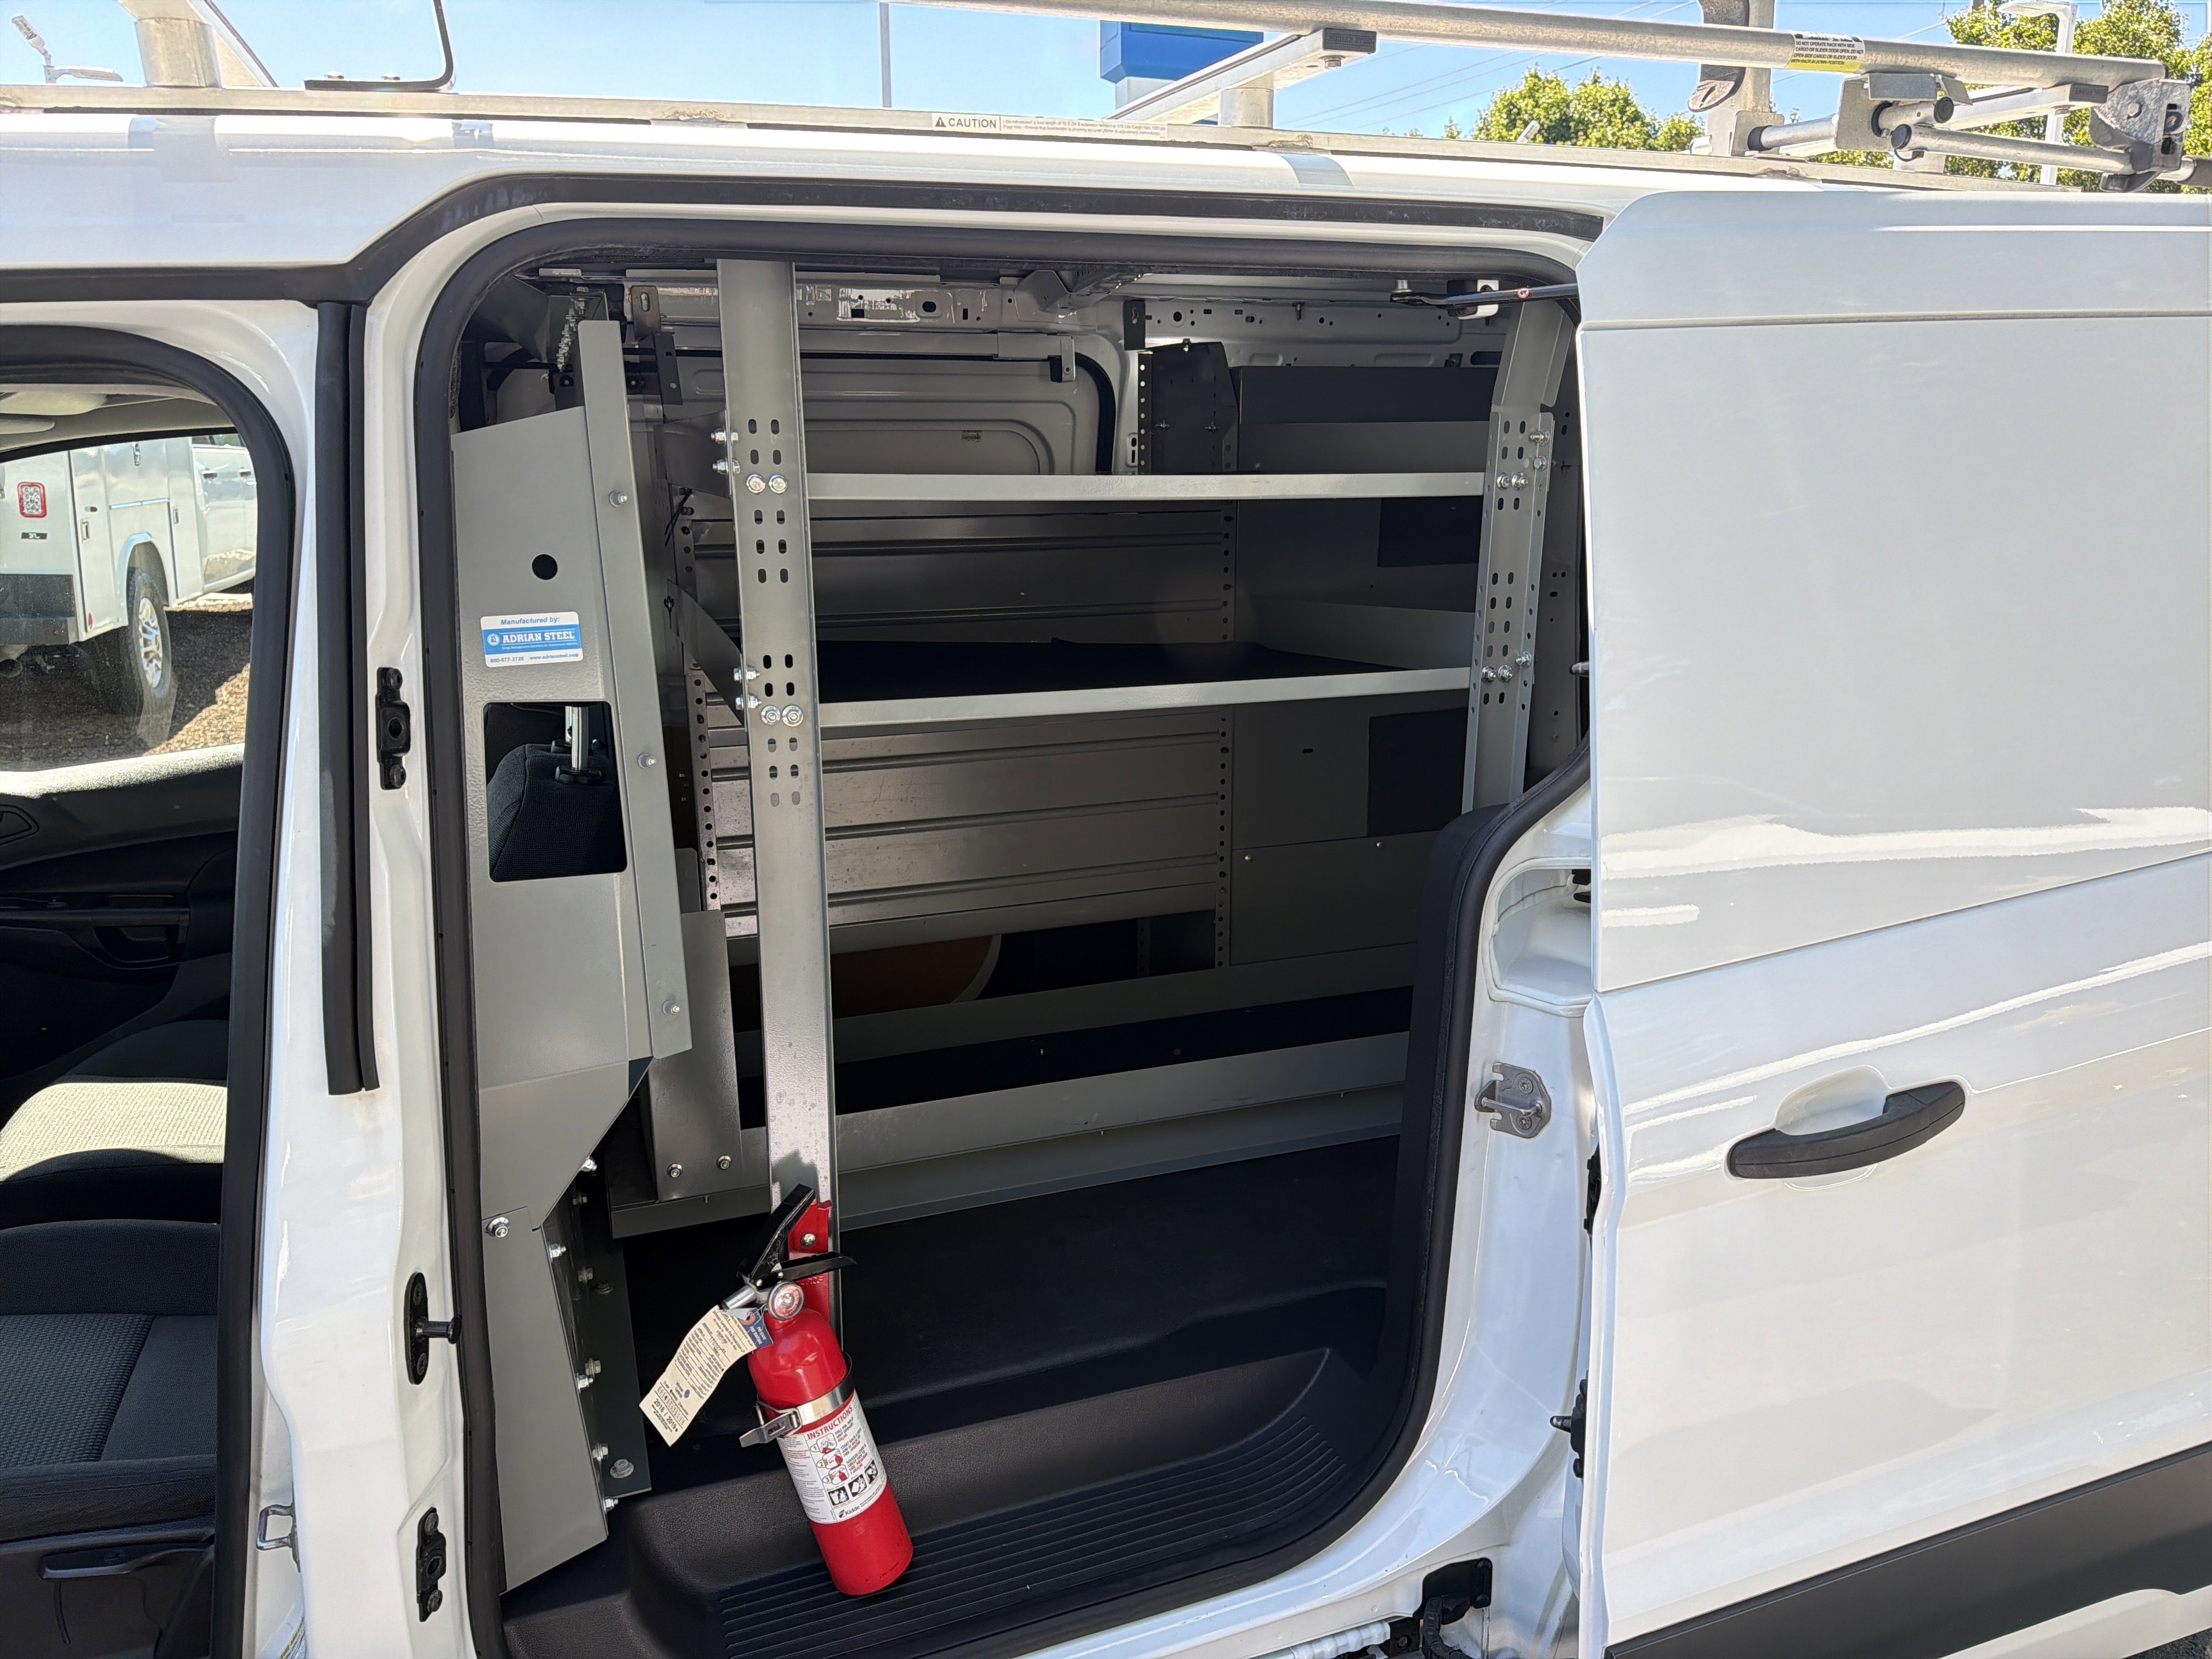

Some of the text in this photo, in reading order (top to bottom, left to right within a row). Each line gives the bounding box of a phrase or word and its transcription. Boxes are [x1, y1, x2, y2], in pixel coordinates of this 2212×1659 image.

[948, 118, 997, 129] CAUTION
[500, 616, 548, 625] Manufactured
[502, 631, 575, 644] ADRIAN STEEL
[654, 1398, 665, 1412] 2018
[666, 1416, 677, 1429] 2019
[807, 1404, 853, 1440] INSTRUCTIONS
[840, 1441, 850, 1449] START
[846, 1453, 858, 1464] SQUEEZE
[845, 1505, 860, 1516] Kidde
